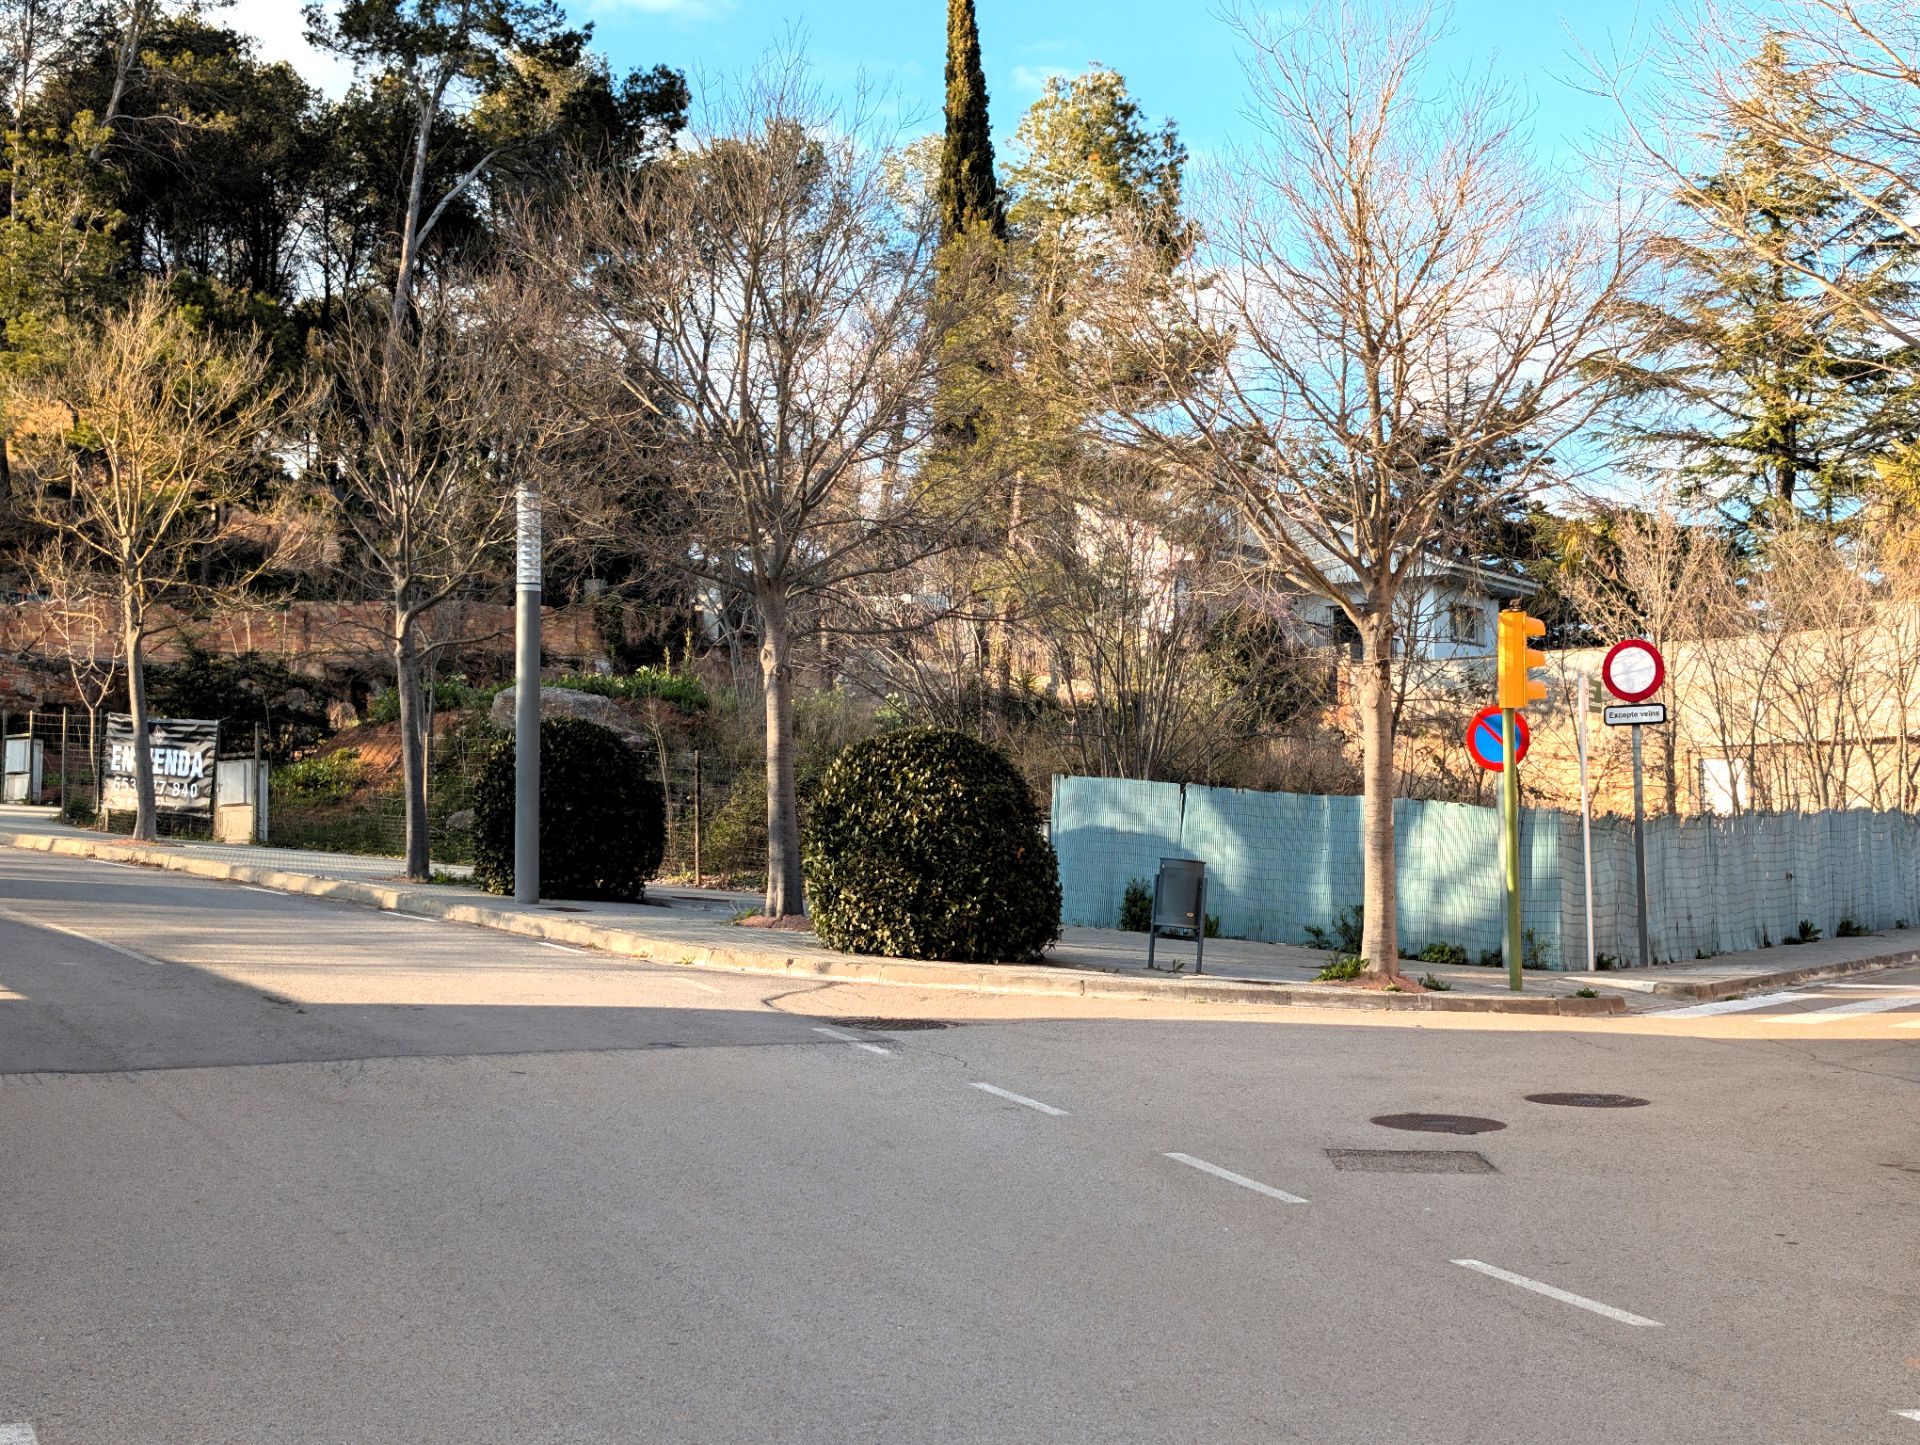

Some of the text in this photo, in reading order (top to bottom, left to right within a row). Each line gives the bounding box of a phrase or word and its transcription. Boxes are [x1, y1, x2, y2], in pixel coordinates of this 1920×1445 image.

[1609, 711, 1638, 719] Excepte
[110, 744, 135, 772] EN
[171, 781, 198, 798] 840
